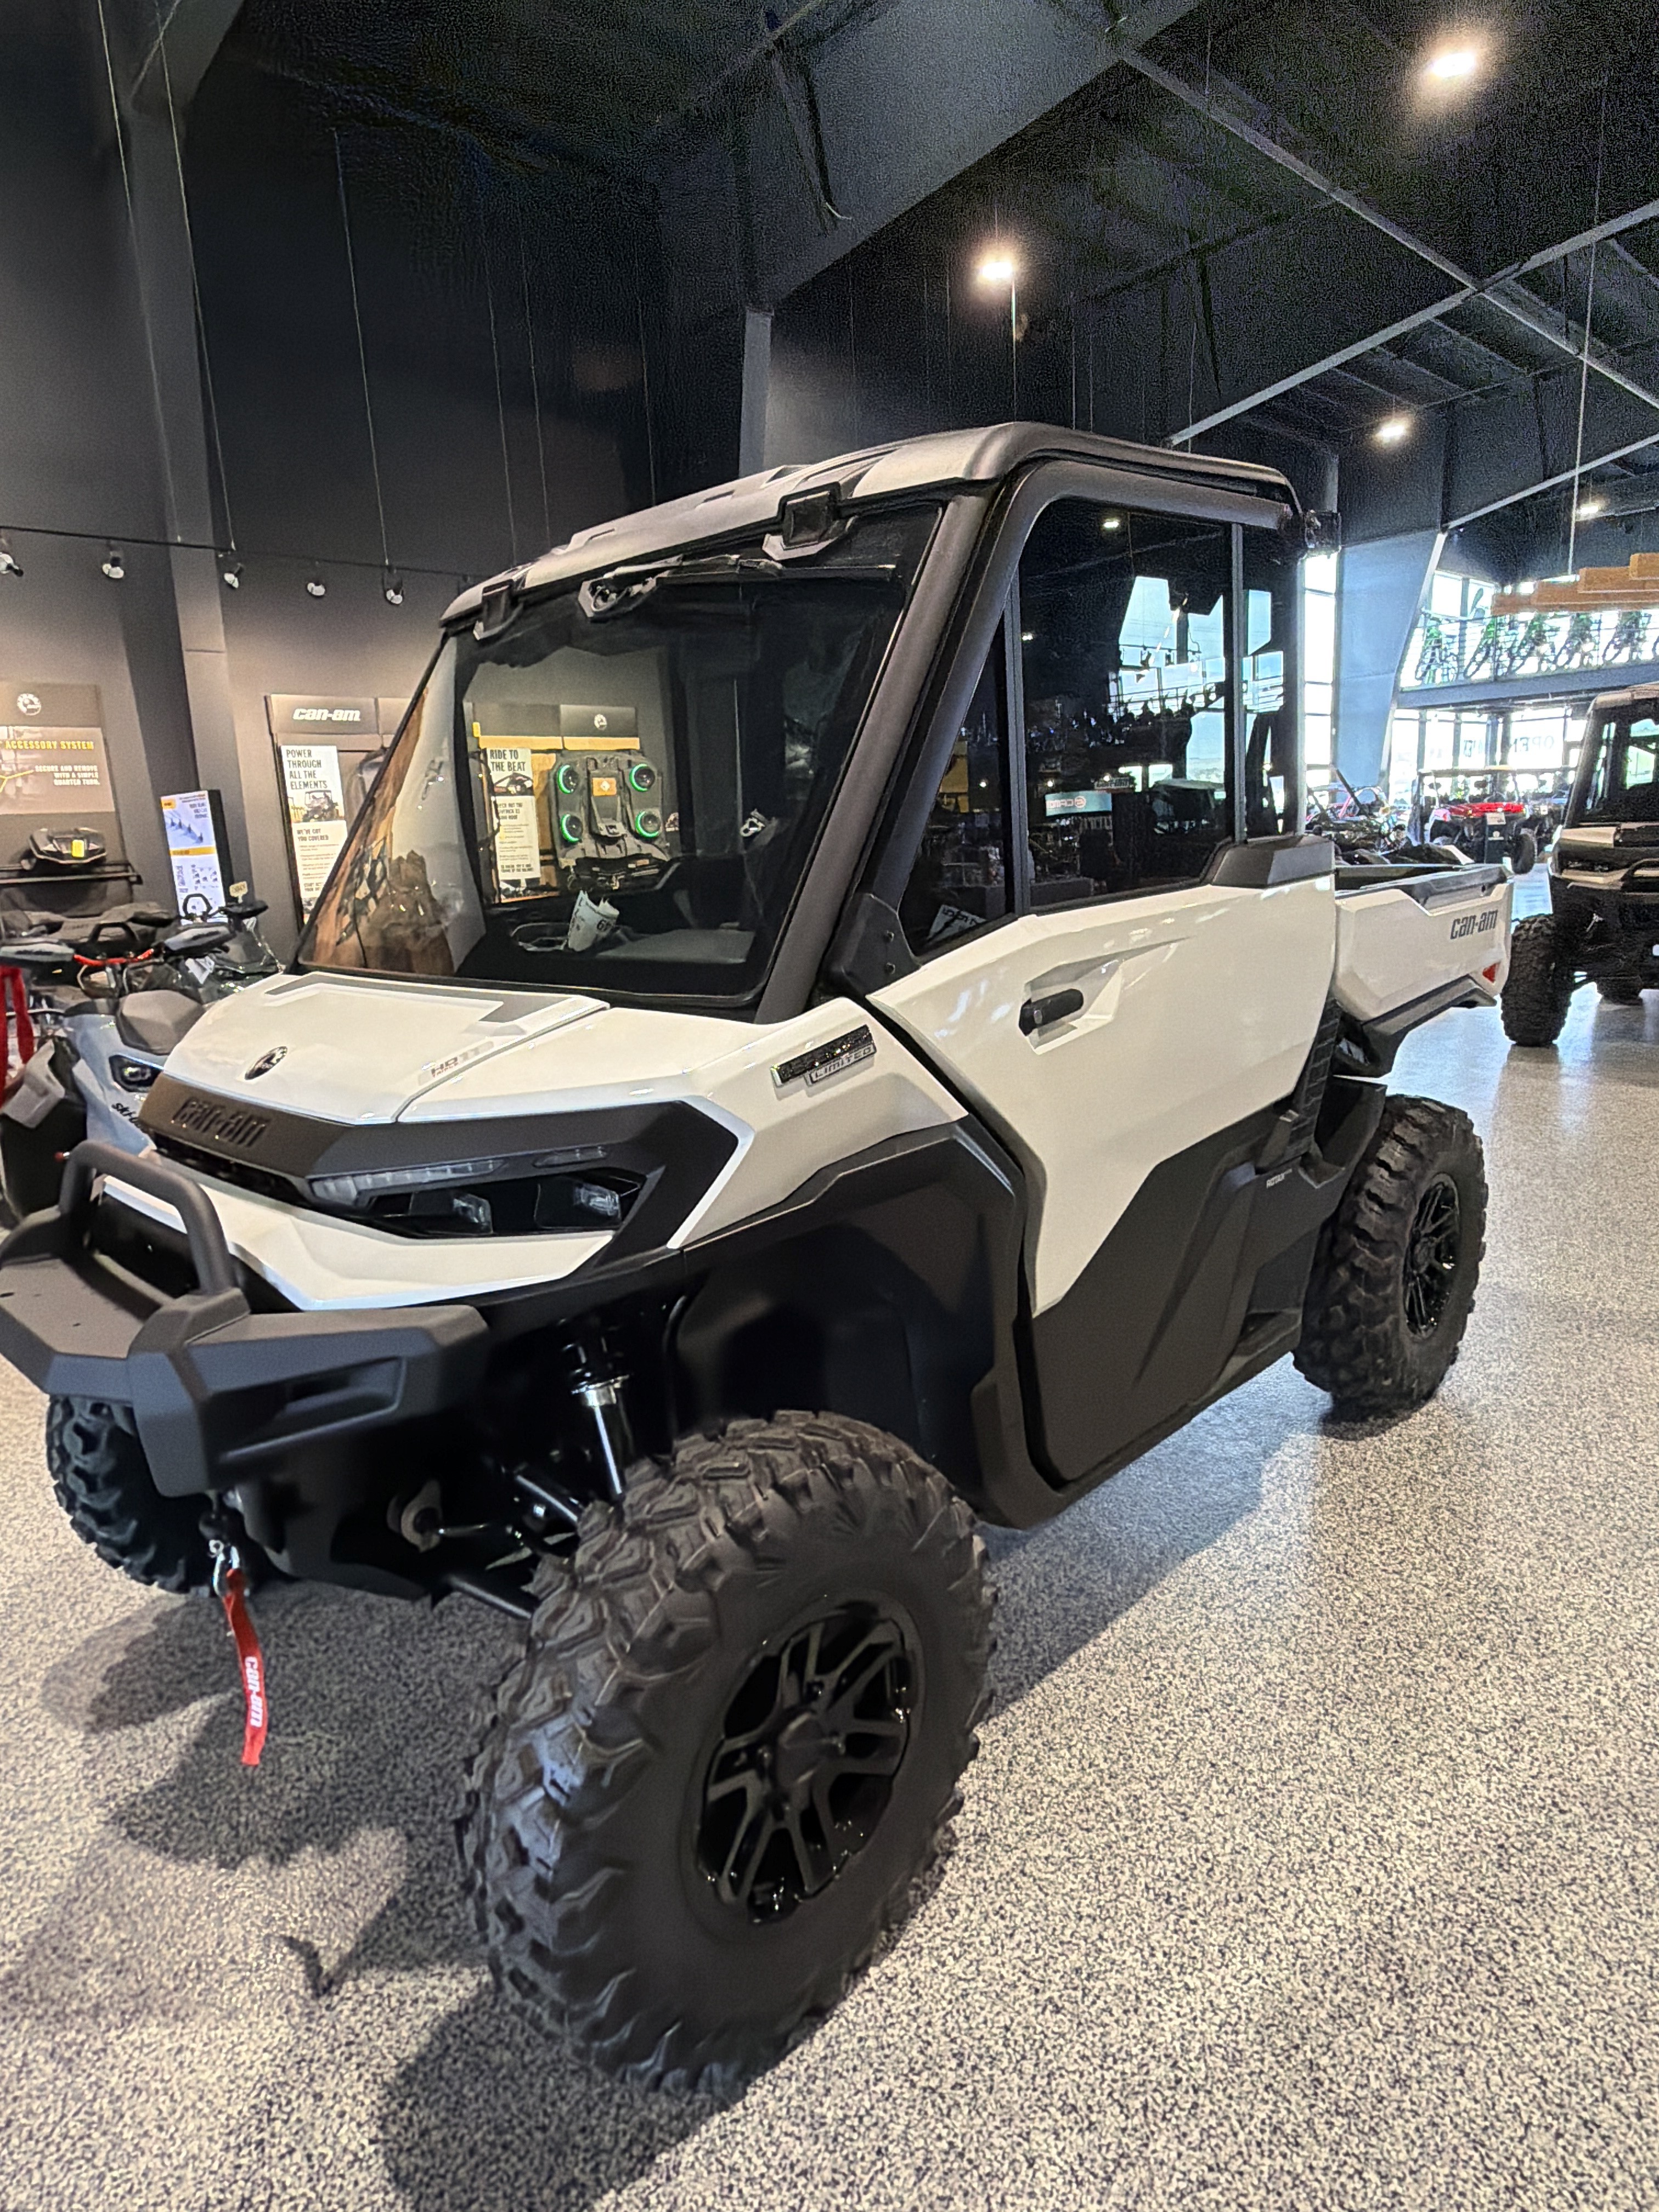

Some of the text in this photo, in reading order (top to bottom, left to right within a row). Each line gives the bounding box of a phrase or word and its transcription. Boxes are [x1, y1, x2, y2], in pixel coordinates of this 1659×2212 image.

[5, 741, 57, 749] ACCESSORY
[60, 741, 94, 749] SYSTEM
[286, 749, 312, 758] POWER
[489, 749, 519, 760] RIDE TO
[287, 760, 321, 768] THROUGH
[491, 761, 526, 771] THE BEAT
[290, 770, 317, 779] ALL THE
[290, 781, 328, 790] ELEMENTS
